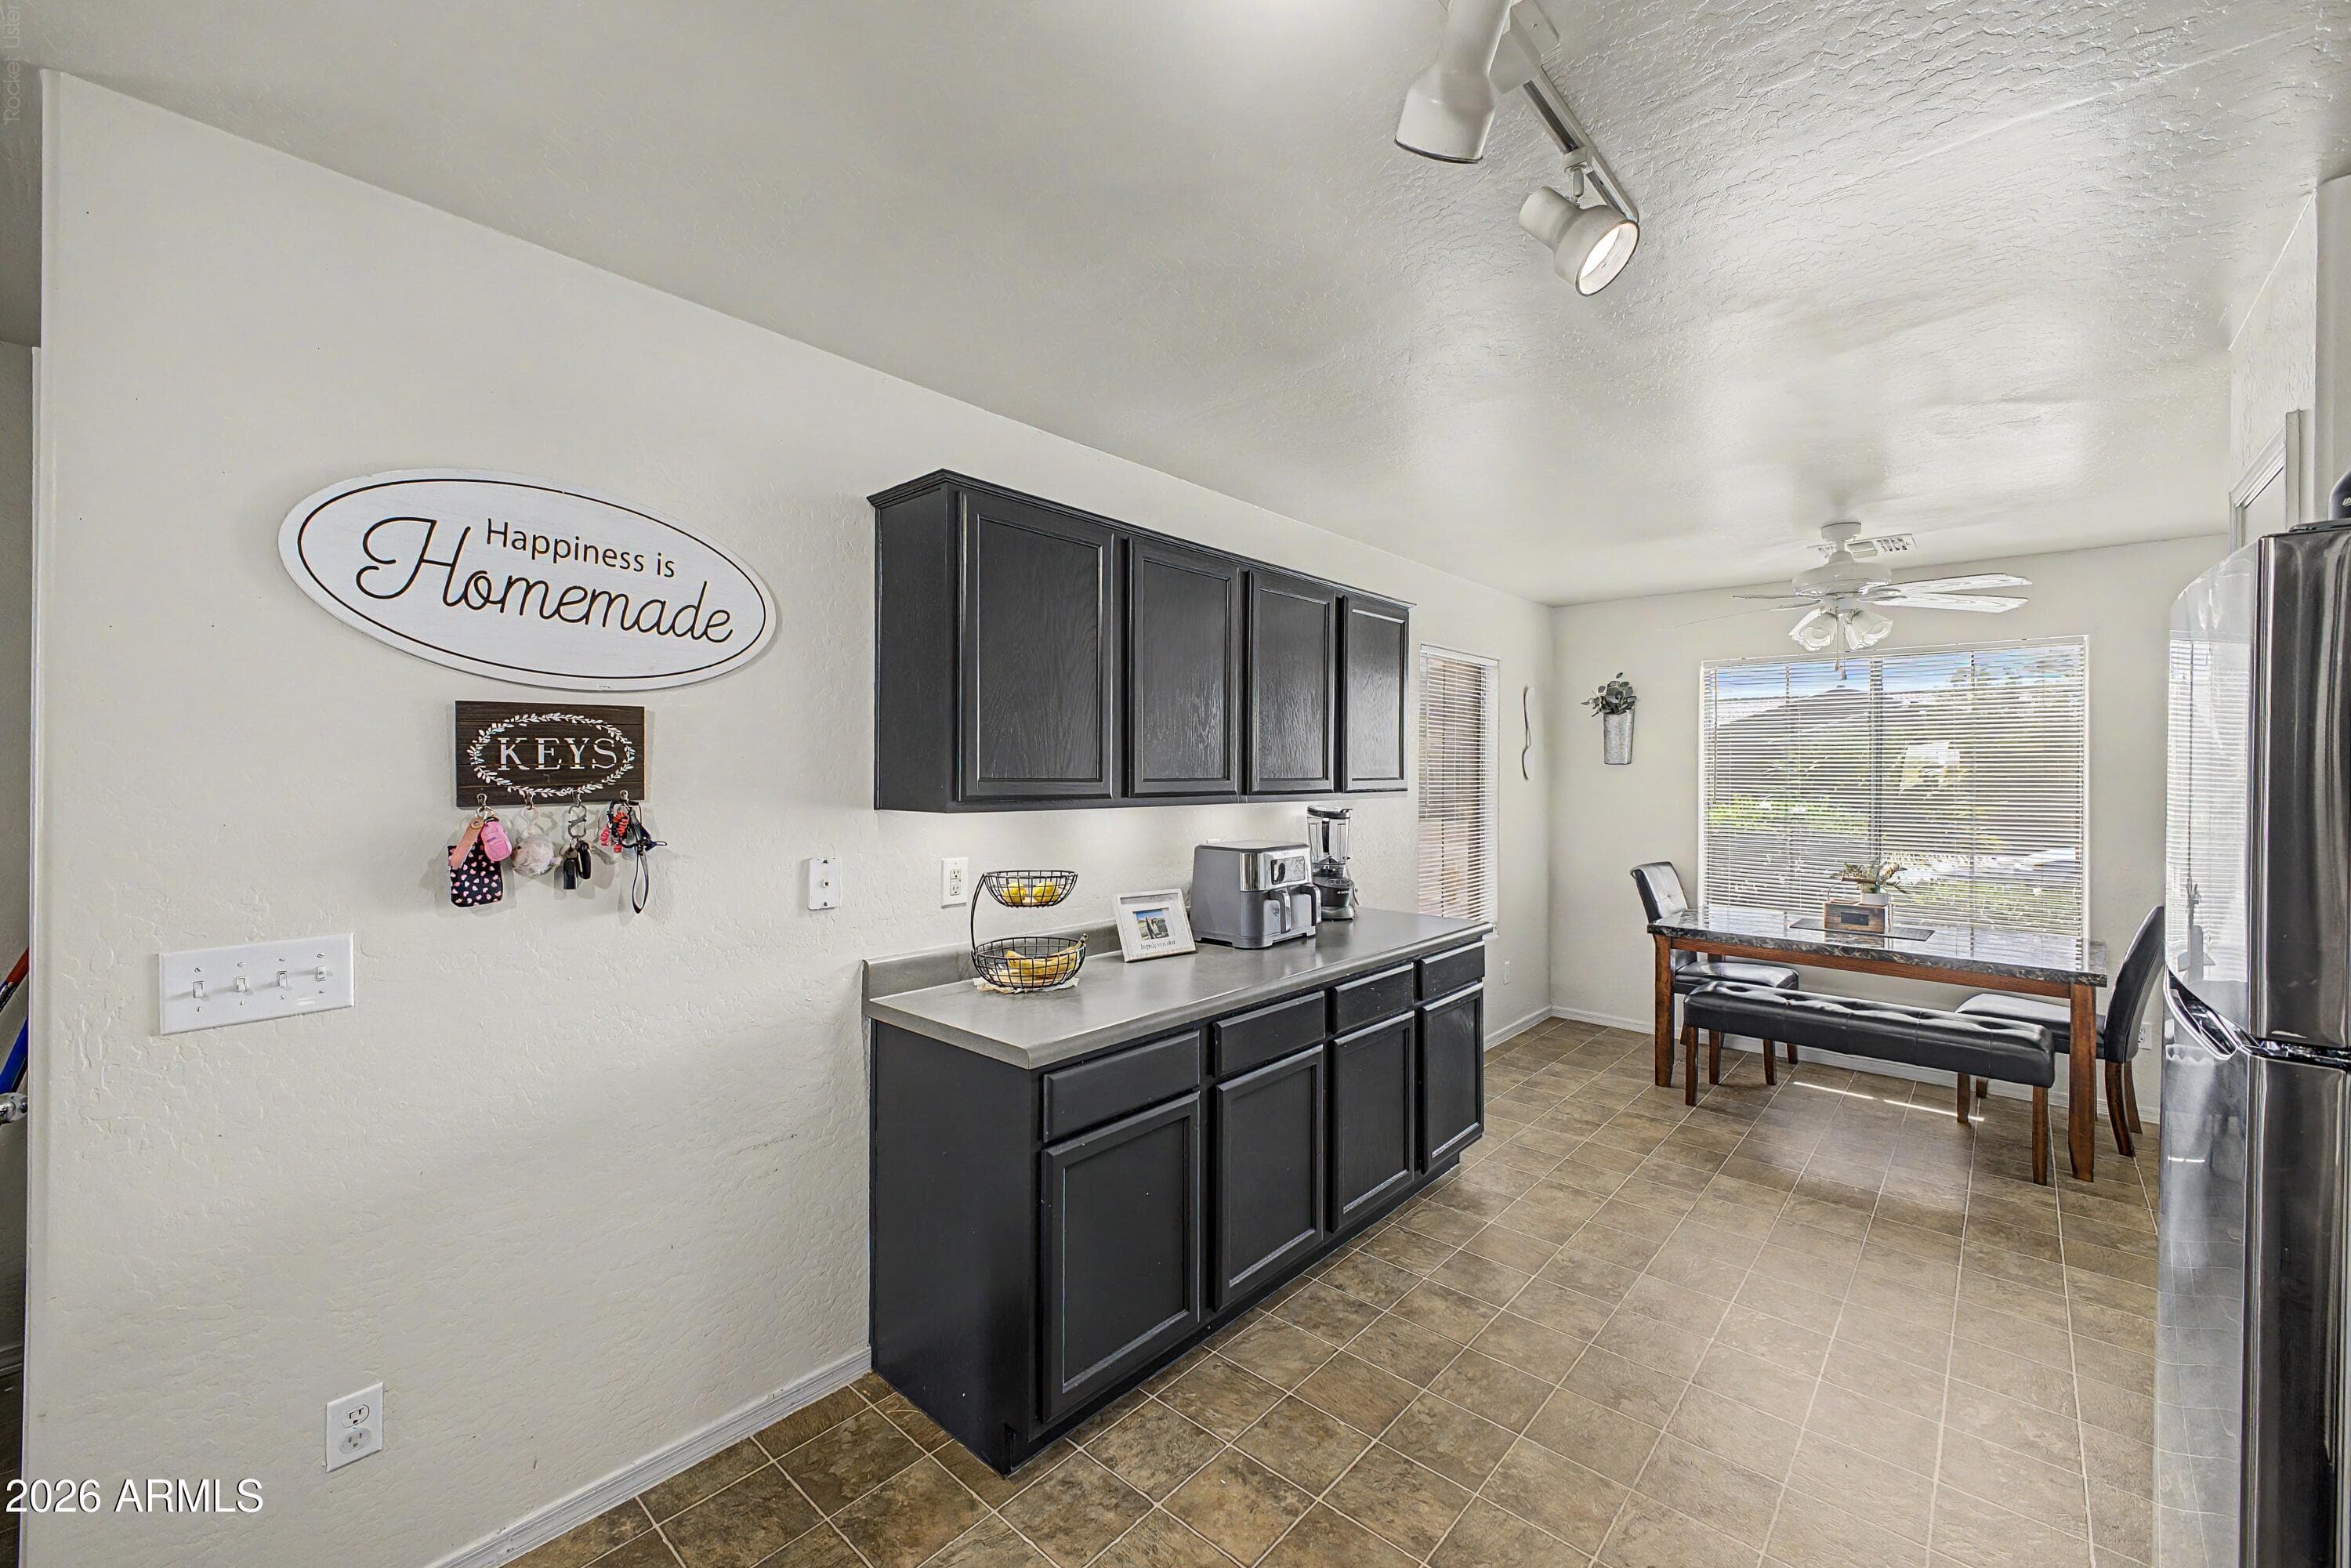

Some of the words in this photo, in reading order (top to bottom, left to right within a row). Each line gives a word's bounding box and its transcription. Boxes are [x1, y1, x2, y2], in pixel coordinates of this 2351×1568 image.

[486, 518, 645, 573] Happiness
[657, 552, 676, 578] is
[355, 516, 734, 643] Homemade
[497, 737, 618, 771] KEYS
